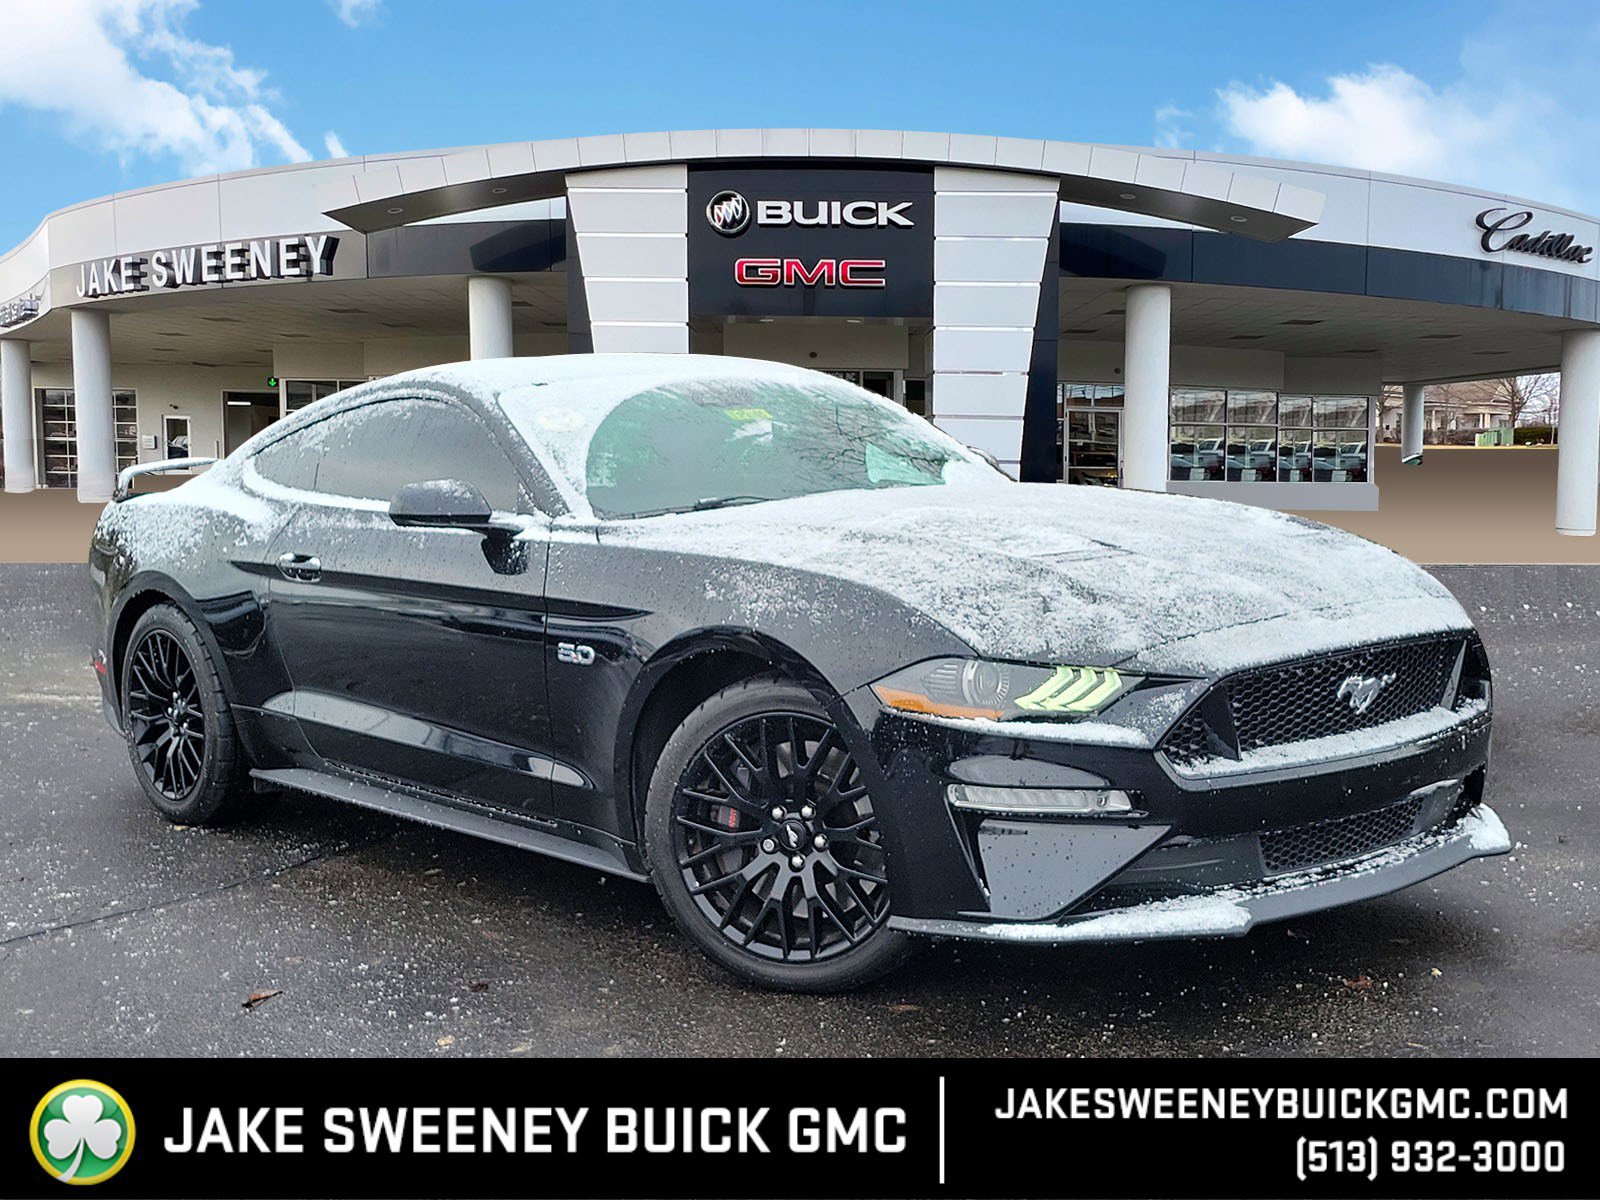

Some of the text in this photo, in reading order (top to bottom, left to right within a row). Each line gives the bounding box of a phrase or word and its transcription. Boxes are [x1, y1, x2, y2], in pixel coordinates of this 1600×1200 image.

[756, 200, 915, 226] BUICK
[1475, 207, 1593, 264] Cadillac
[76, 234, 332, 298] JAKE SWEENEY
[734, 258, 886, 287] GMC
